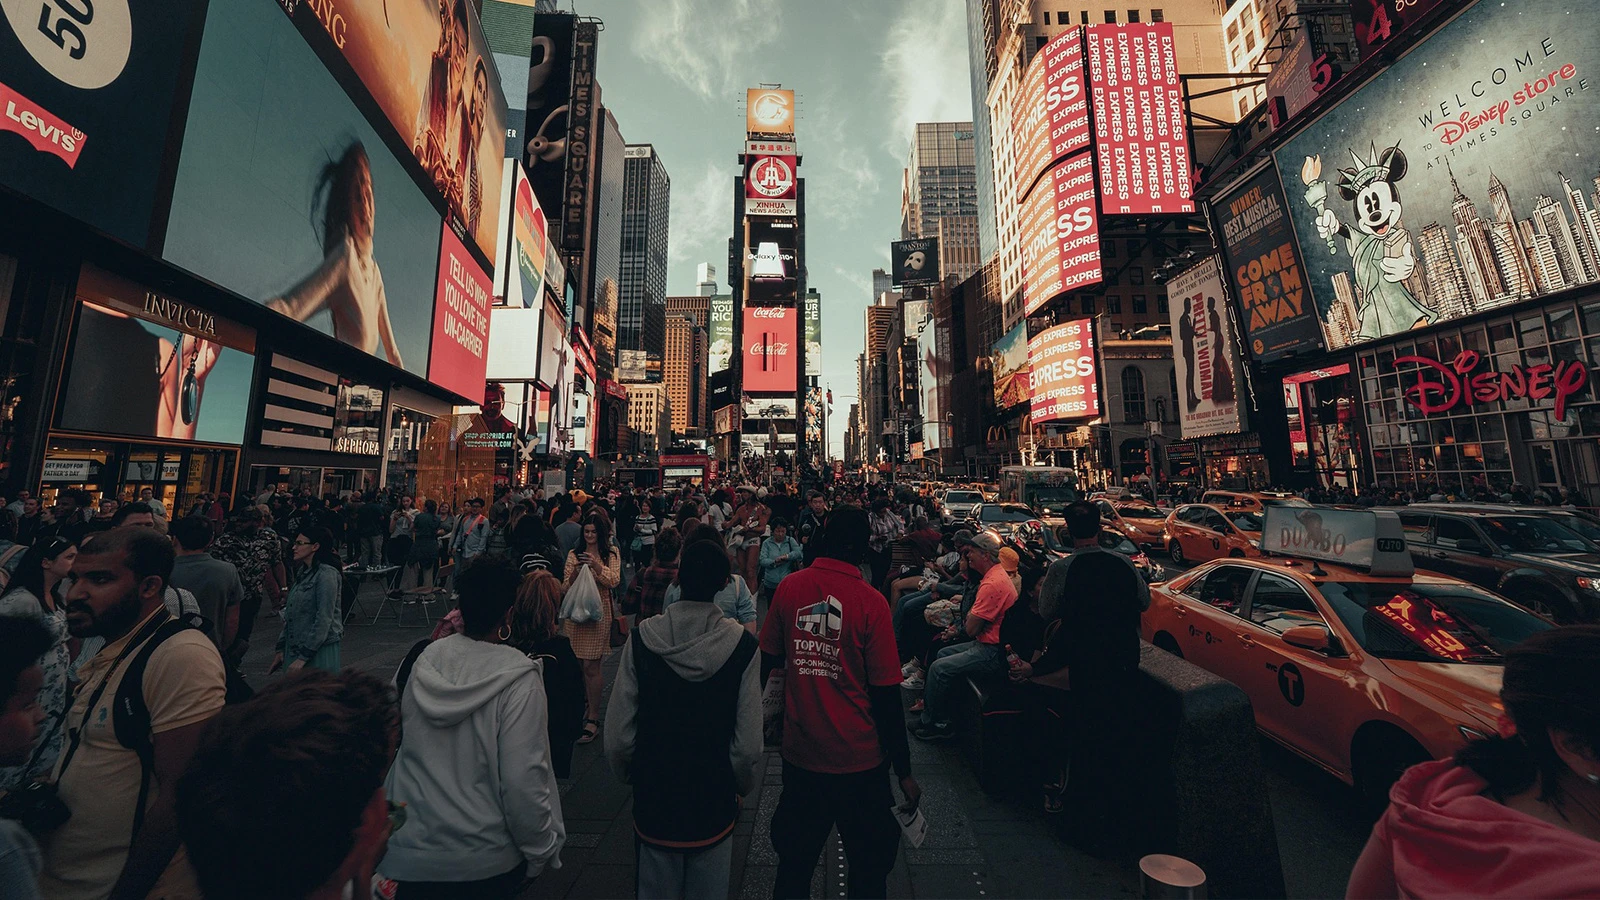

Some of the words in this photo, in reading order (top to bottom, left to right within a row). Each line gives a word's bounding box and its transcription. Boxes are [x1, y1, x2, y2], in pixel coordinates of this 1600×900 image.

[576, 41, 592, 117] TIMES
[1089, 34, 1102, 82] EXPRESS
[1104, 38, 1117, 86] EXPRESS
[1118, 33, 1131, 81] EXPRESS
[1134, 37, 1147, 86] EXPRESS
[1147, 32, 1161, 80] EXPRESS
[1162, 36, 1176, 85] EXPRESS
[1418, 37, 1556, 128] WELCOME
[1015, 76, 1080, 155] EXPRESS
[1094, 88, 1107, 138] EXPRESS
[1110, 91, 1123, 142] EXPRESS
[1124, 87, 1137, 137] EXPRESS
[1140, 91, 1154, 141] EXPRESS
[1154, 86, 1168, 136] EXPRESS
[1169, 90, 1183, 141] EXPRESS
[1422, 143, 1433, 152] TO
[1432, 100, 1510, 145] Disney
[1512, 63, 1577, 105] store
[1426, 156, 1440, 170] AT
[1449, 127, 1498, 157] TIMES
[1509, 78, 1589, 126] SQUARE
[569, 126, 588, 223] SQUARE
[1100, 144, 1113, 195] EXPRESS
[1115, 148, 1128, 200] EXPRESS
[1129, 143, 1143, 195] EXPRESS
[1146, 147, 1160, 199] EXPRESS
[1160, 142, 1174, 194] EXPRESS
[1175, 147, 1190, 199] EXPRESS
[1223, 214, 1244, 240] BEST
[1242, 193, 1281, 228] MUSICAL
[1229, 185, 1263, 217] WINNER!
[1023, 207, 1093, 271] EXPRESS
[1234, 227, 1251, 244] ACROSS
[1262, 208, 1284, 227] AMERICA
[449, 252, 465, 289] TELL
[465, 272, 474, 298] US
[474, 281, 488, 311] WHY
[1170, 287, 1185, 299] GOOD
[1185, 281, 1197, 293] TIME
[1198, 270, 1219, 285] TONIGH
[1176, 276, 1190, 289] HAVE
[1194, 264, 1213, 280] REALLY
[1237, 241, 1296, 287] COME
[142, 290, 216, 337] INVICTA
[444, 278, 460, 312] YOU
[459, 291, 476, 327] LOVE
[475, 309, 487, 337] THE
[1192, 292, 1208, 339] PRETTY
[1249, 285, 1303, 333] AWAY
[443, 310, 483, 359] UN-CARRIER
[1044, 325, 1080, 342] EXPRESS
[1044, 340, 1081, 356] EXPRESS
[1029, 356, 1093, 390] EXPRESS
[1047, 385, 1085, 400] EXPRESS
[1197, 345, 1213, 401] WOMAN
[1049, 401, 1087, 414] EXPRESS
[338, 436, 380, 456] SEPHORA
[794, 638, 841, 657] TOPVIEW
[1265, 662, 1278, 672] NYC
[798, 667, 838, 681] SIGHTSEEING
[1283, 670, 1299, 701] T
